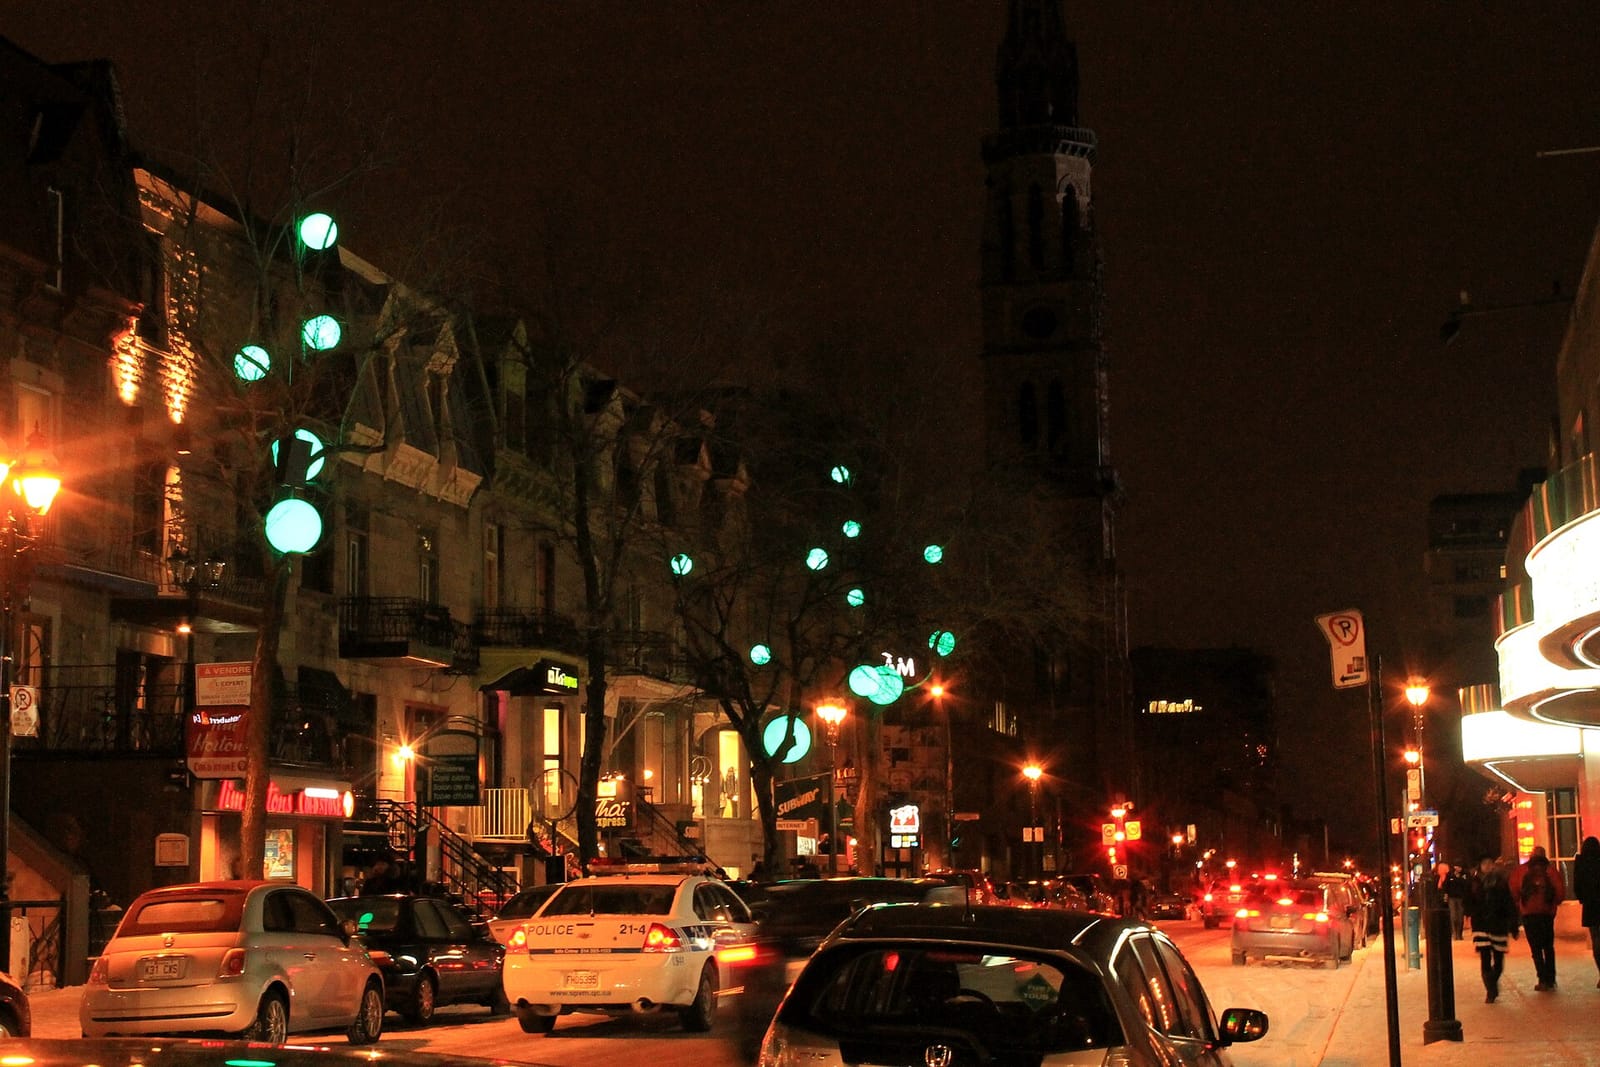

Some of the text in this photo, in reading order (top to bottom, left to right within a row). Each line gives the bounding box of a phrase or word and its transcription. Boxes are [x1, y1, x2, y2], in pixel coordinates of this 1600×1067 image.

[595, 797, 630, 817] Thaï
[777, 787, 820, 816] SUBWAY
[528, 925, 575, 935] POLICE
[619, 923, 646, 935] 21-4
